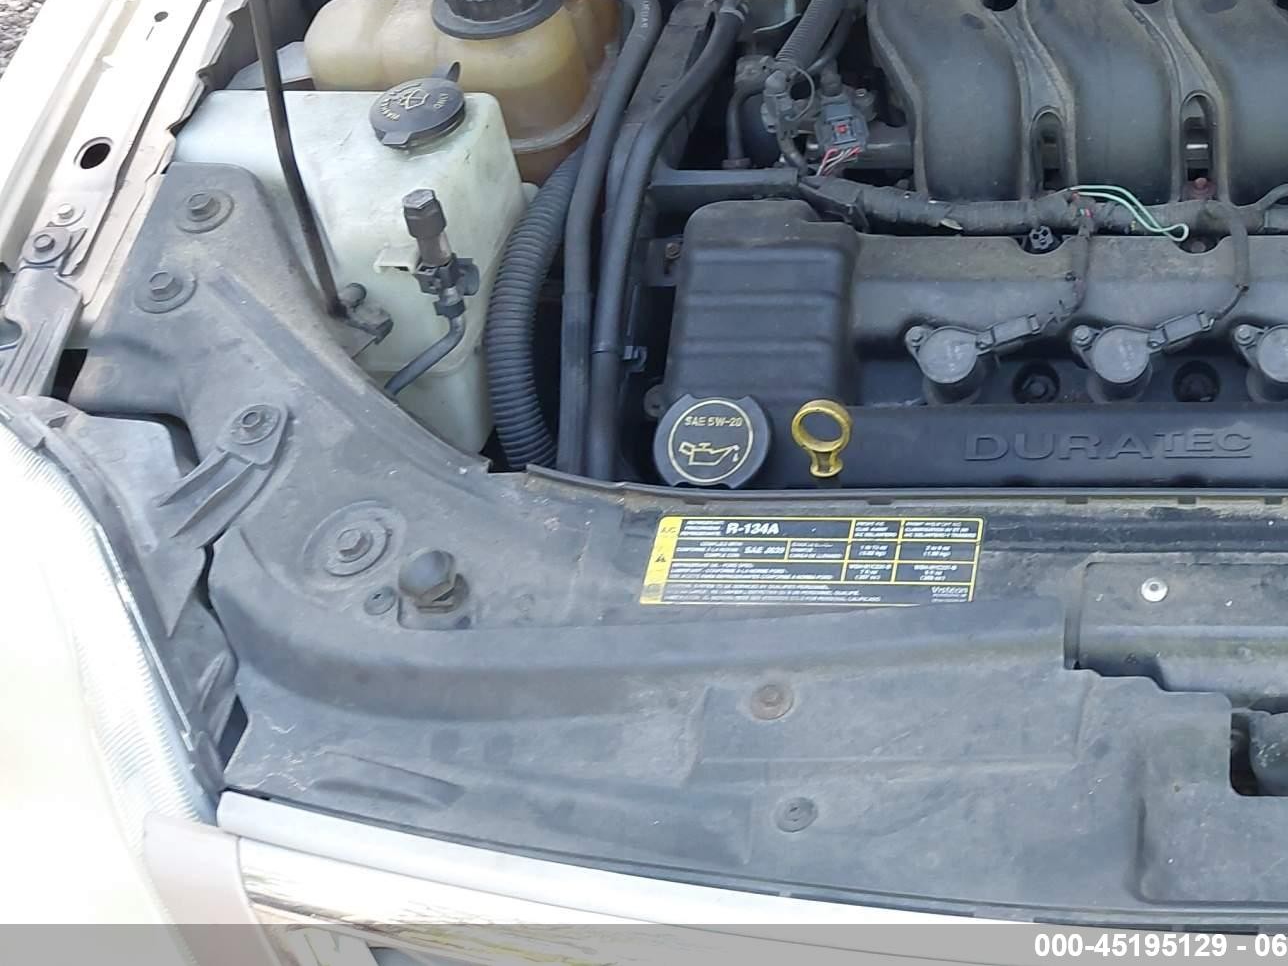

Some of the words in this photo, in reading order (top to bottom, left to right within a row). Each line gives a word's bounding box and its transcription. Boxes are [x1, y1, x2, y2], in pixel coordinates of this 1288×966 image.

[684, 415, 707, 427] SAE
[707, 416, 743, 427] 5W-20
[962, 432, 1254, 463] DURATEC
[725, 521, 780, 536] R-134A
